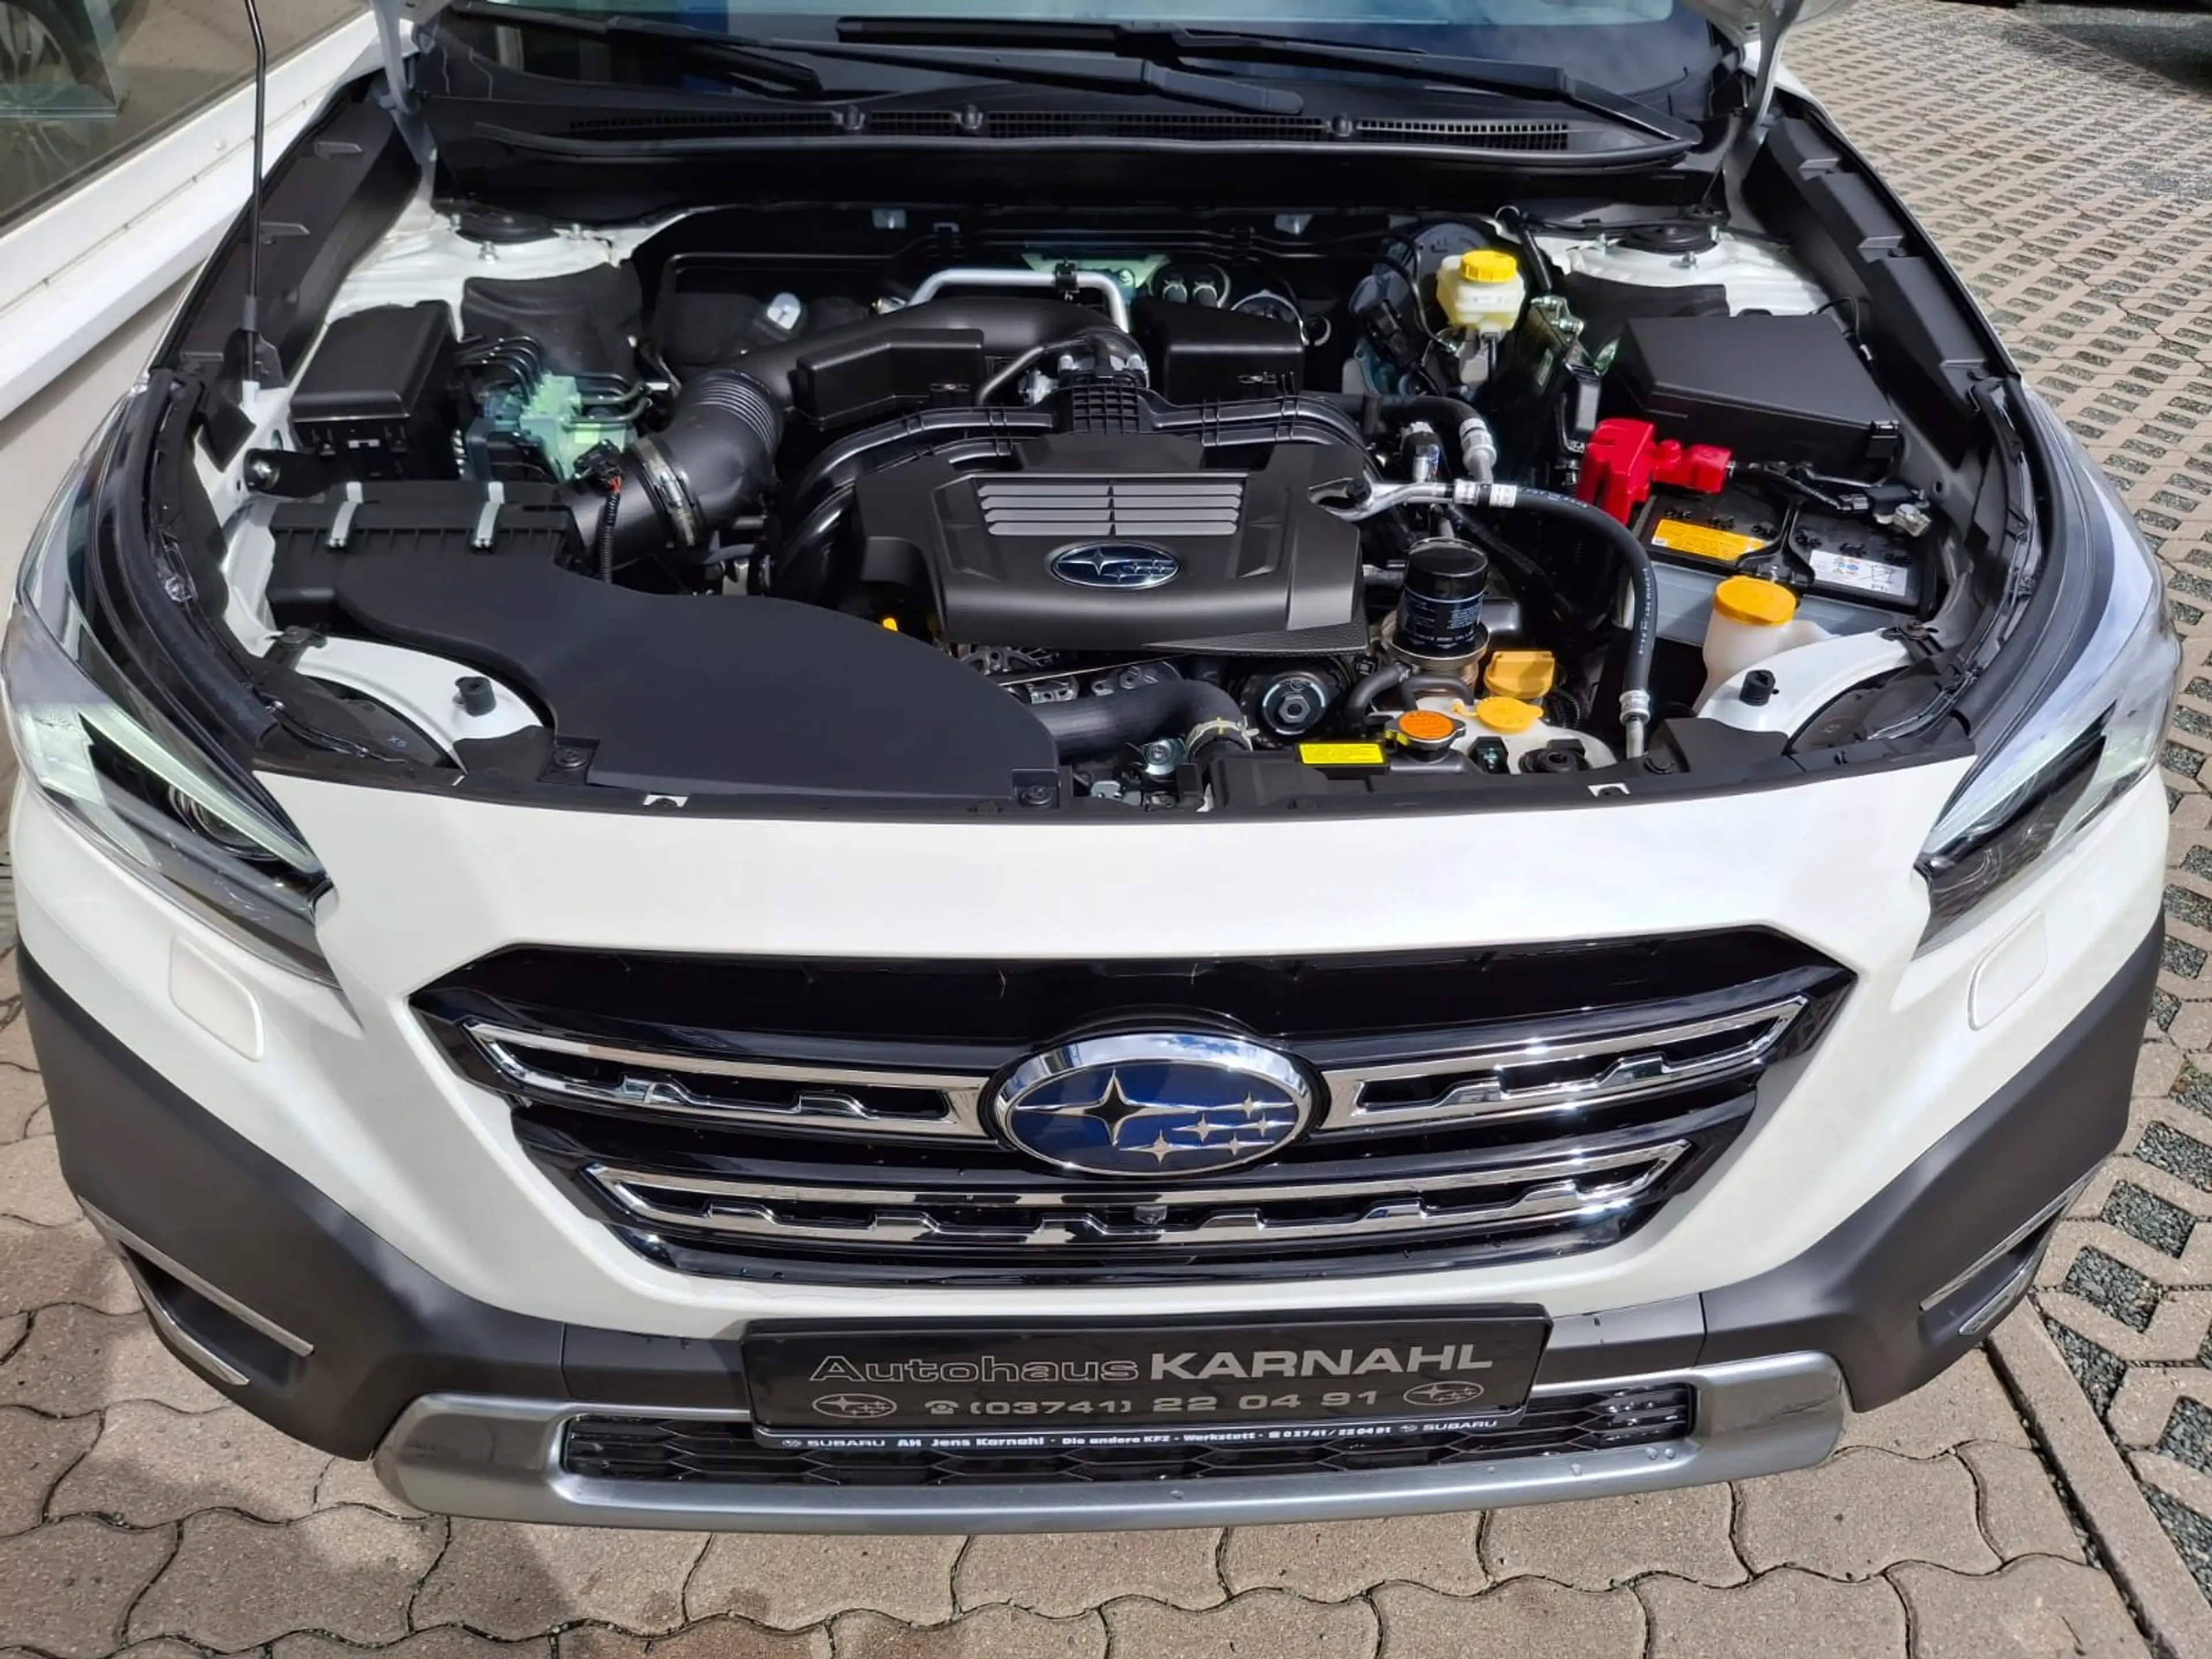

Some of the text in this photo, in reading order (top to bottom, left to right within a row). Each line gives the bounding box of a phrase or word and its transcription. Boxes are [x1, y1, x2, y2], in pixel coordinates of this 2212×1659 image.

[809, 1344, 1493, 1382] Autohaus KARNAHL
[970, 1391, 1377, 1414] (03741) 22 04 91
[897, 1439, 922, 1447] AH
[976, 1437, 1044, 1446] Karnahl
[1089, 1436, 1141, 1444] andere
[1183, 1432, 1255, 1441] Werkstatt
[1422, 1421, 1497, 1431] SUBARU
